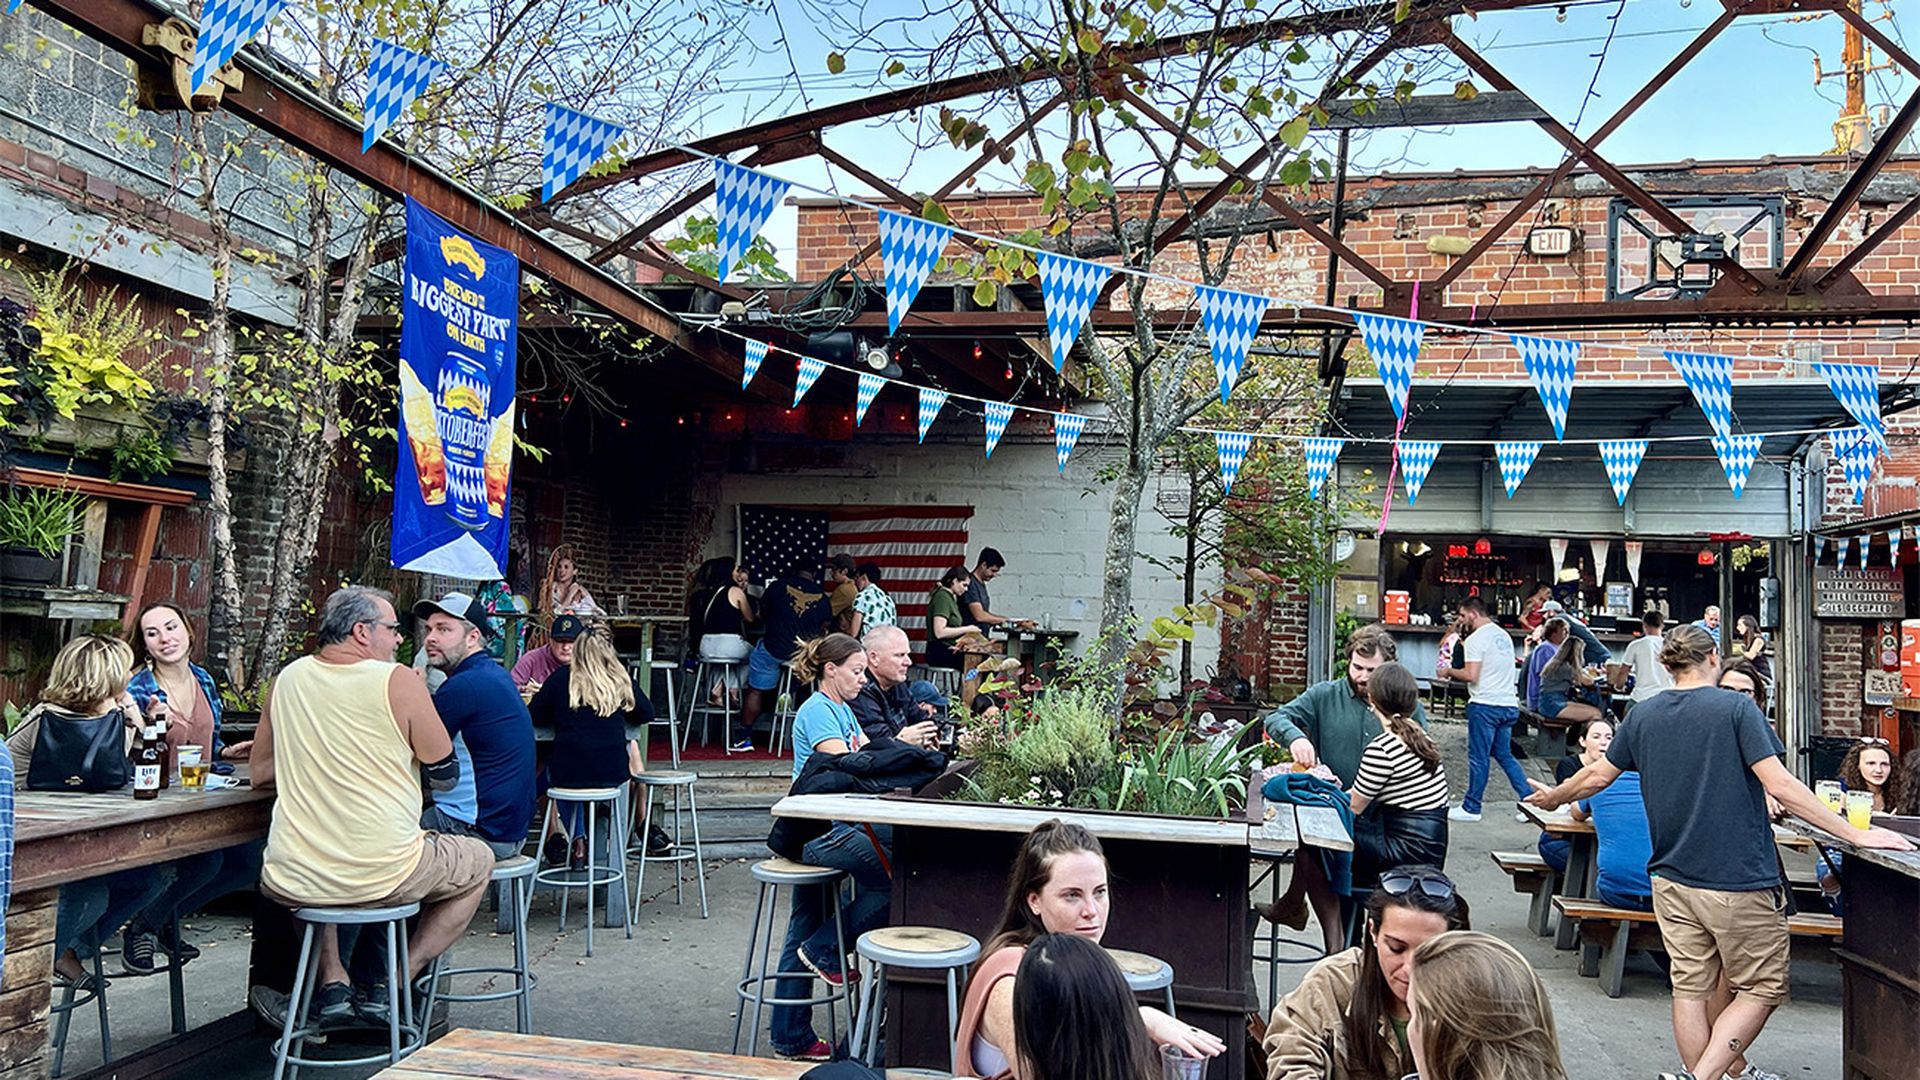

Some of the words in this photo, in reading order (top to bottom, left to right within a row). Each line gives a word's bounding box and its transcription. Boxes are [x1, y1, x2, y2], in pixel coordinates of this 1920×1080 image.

[1539, 232, 1565, 250] EXIT
[443, 276, 478, 307] BREWED
[410, 273, 471, 330] BIGGEST
[446, 321, 459, 341] ON
[460, 329, 486, 353] EARTH
[1817, 581, 1829, 590] IN
[1831, 581, 1853, 590] OPEN
[1855, 581, 1901, 590] POSITION
[1822, 592, 1851, 601] WHILE
[1852, 592, 1903, 602] BUILDI
[1830, 603, 1843, 612] IS
[1845, 603, 1892, 613] OCCUPIED
